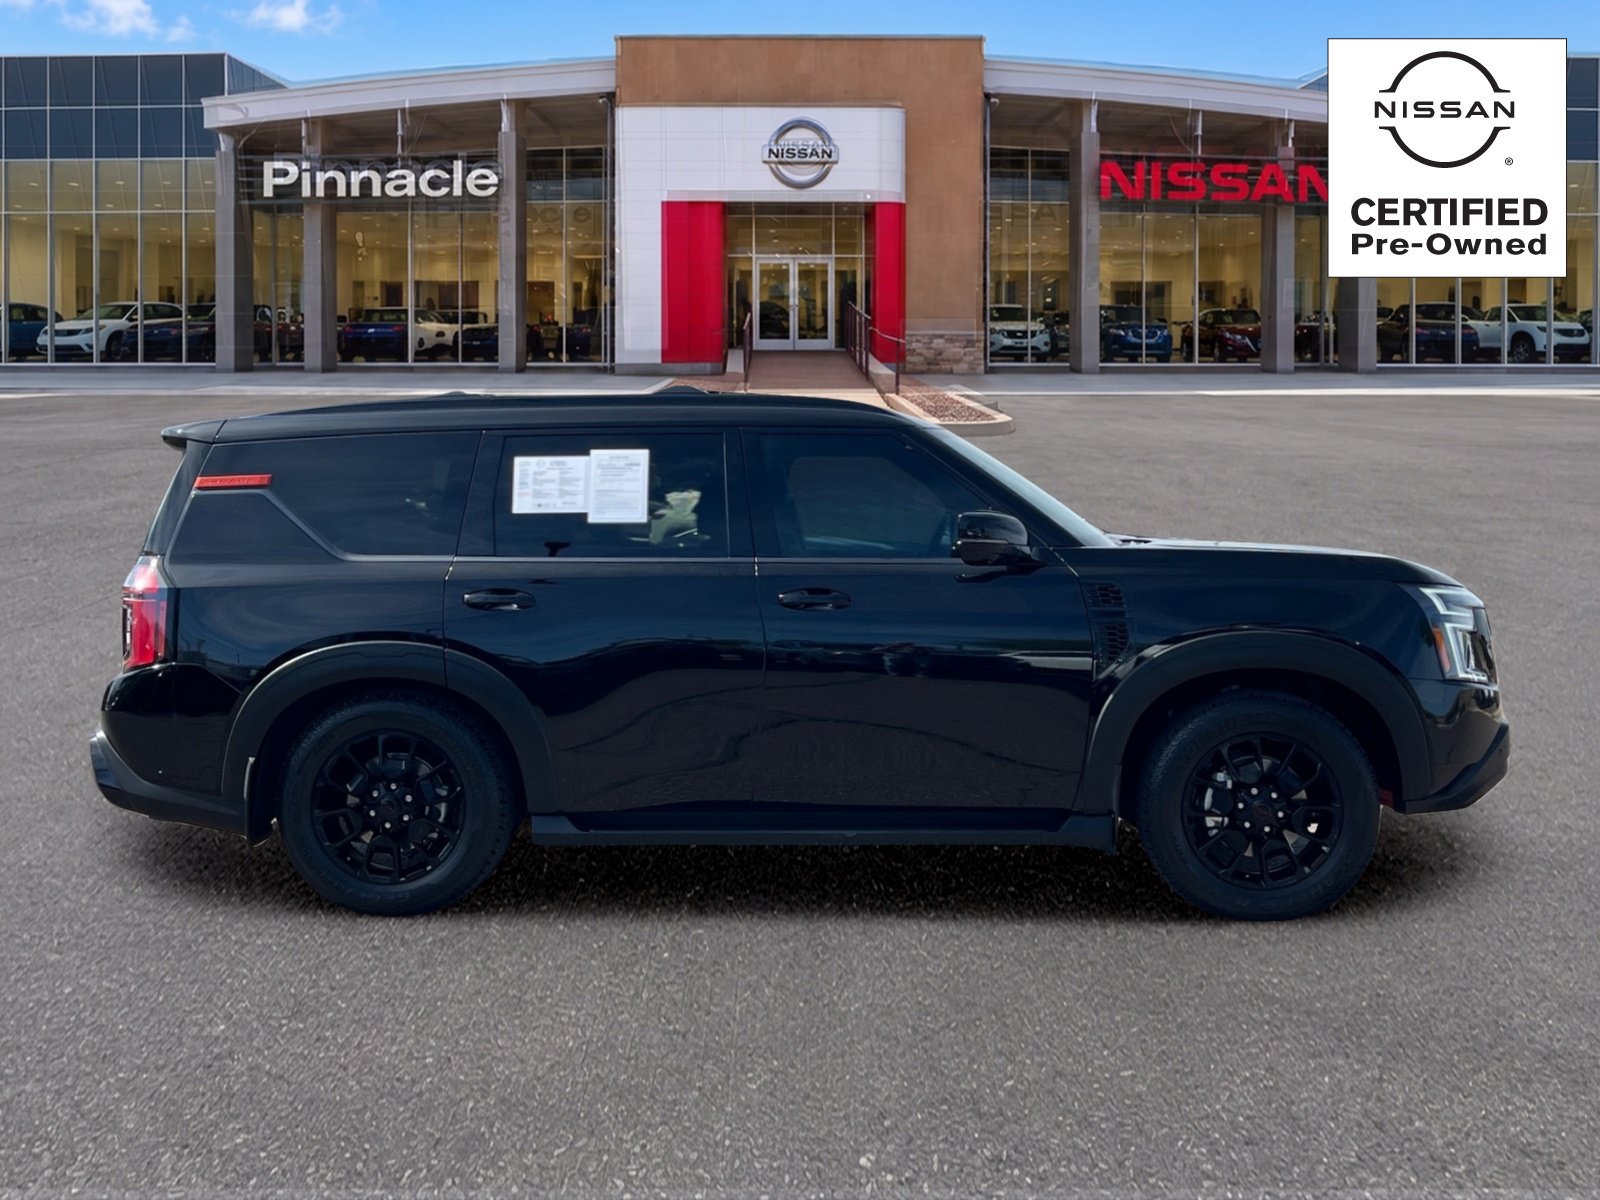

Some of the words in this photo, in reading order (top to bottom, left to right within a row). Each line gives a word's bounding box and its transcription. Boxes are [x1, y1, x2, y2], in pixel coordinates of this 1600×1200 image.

[767, 147, 833, 159] NISSAN
[263, 159, 499, 197] Pinnacle
[1100, 161, 1328, 203] NISSAN
